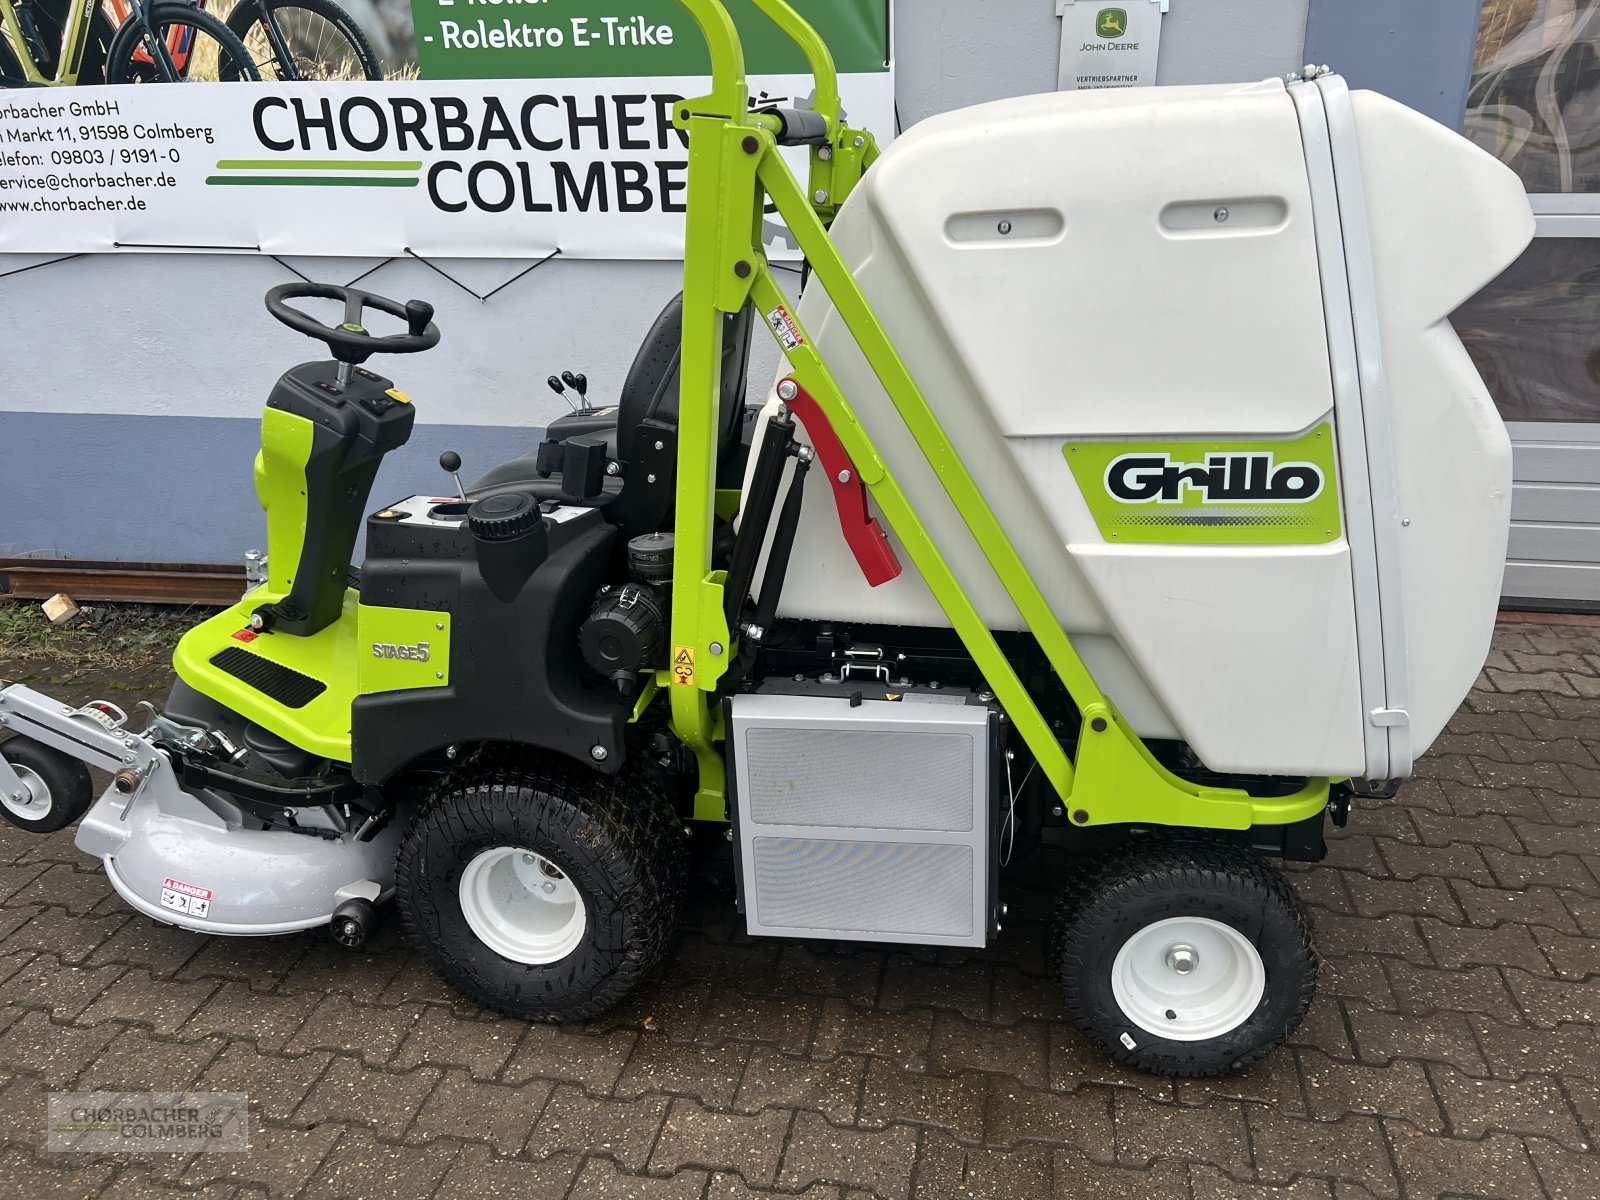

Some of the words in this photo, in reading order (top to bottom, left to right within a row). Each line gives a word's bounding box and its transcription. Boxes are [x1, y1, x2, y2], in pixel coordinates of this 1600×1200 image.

[440, 19, 564, 49] Rolektro
[570, 16, 674, 47] E-Trike
[1080, 42, 1106, 51] JOHN
[1108, 42, 1139, 51] DEERE
[69, 100, 120, 116] GmbH
[6, 126, 54, 143] Markt
[56, 127, 76, 143] 11,
[79, 125, 129, 140] 91598
[133, 123, 215, 144] Colmberg
[51, 149, 105, 165] 09803
[110, 149, 115, 166] /
[1106, 455, 1321, 501] Grillo
[172, 881, 209, 898] DANGER
